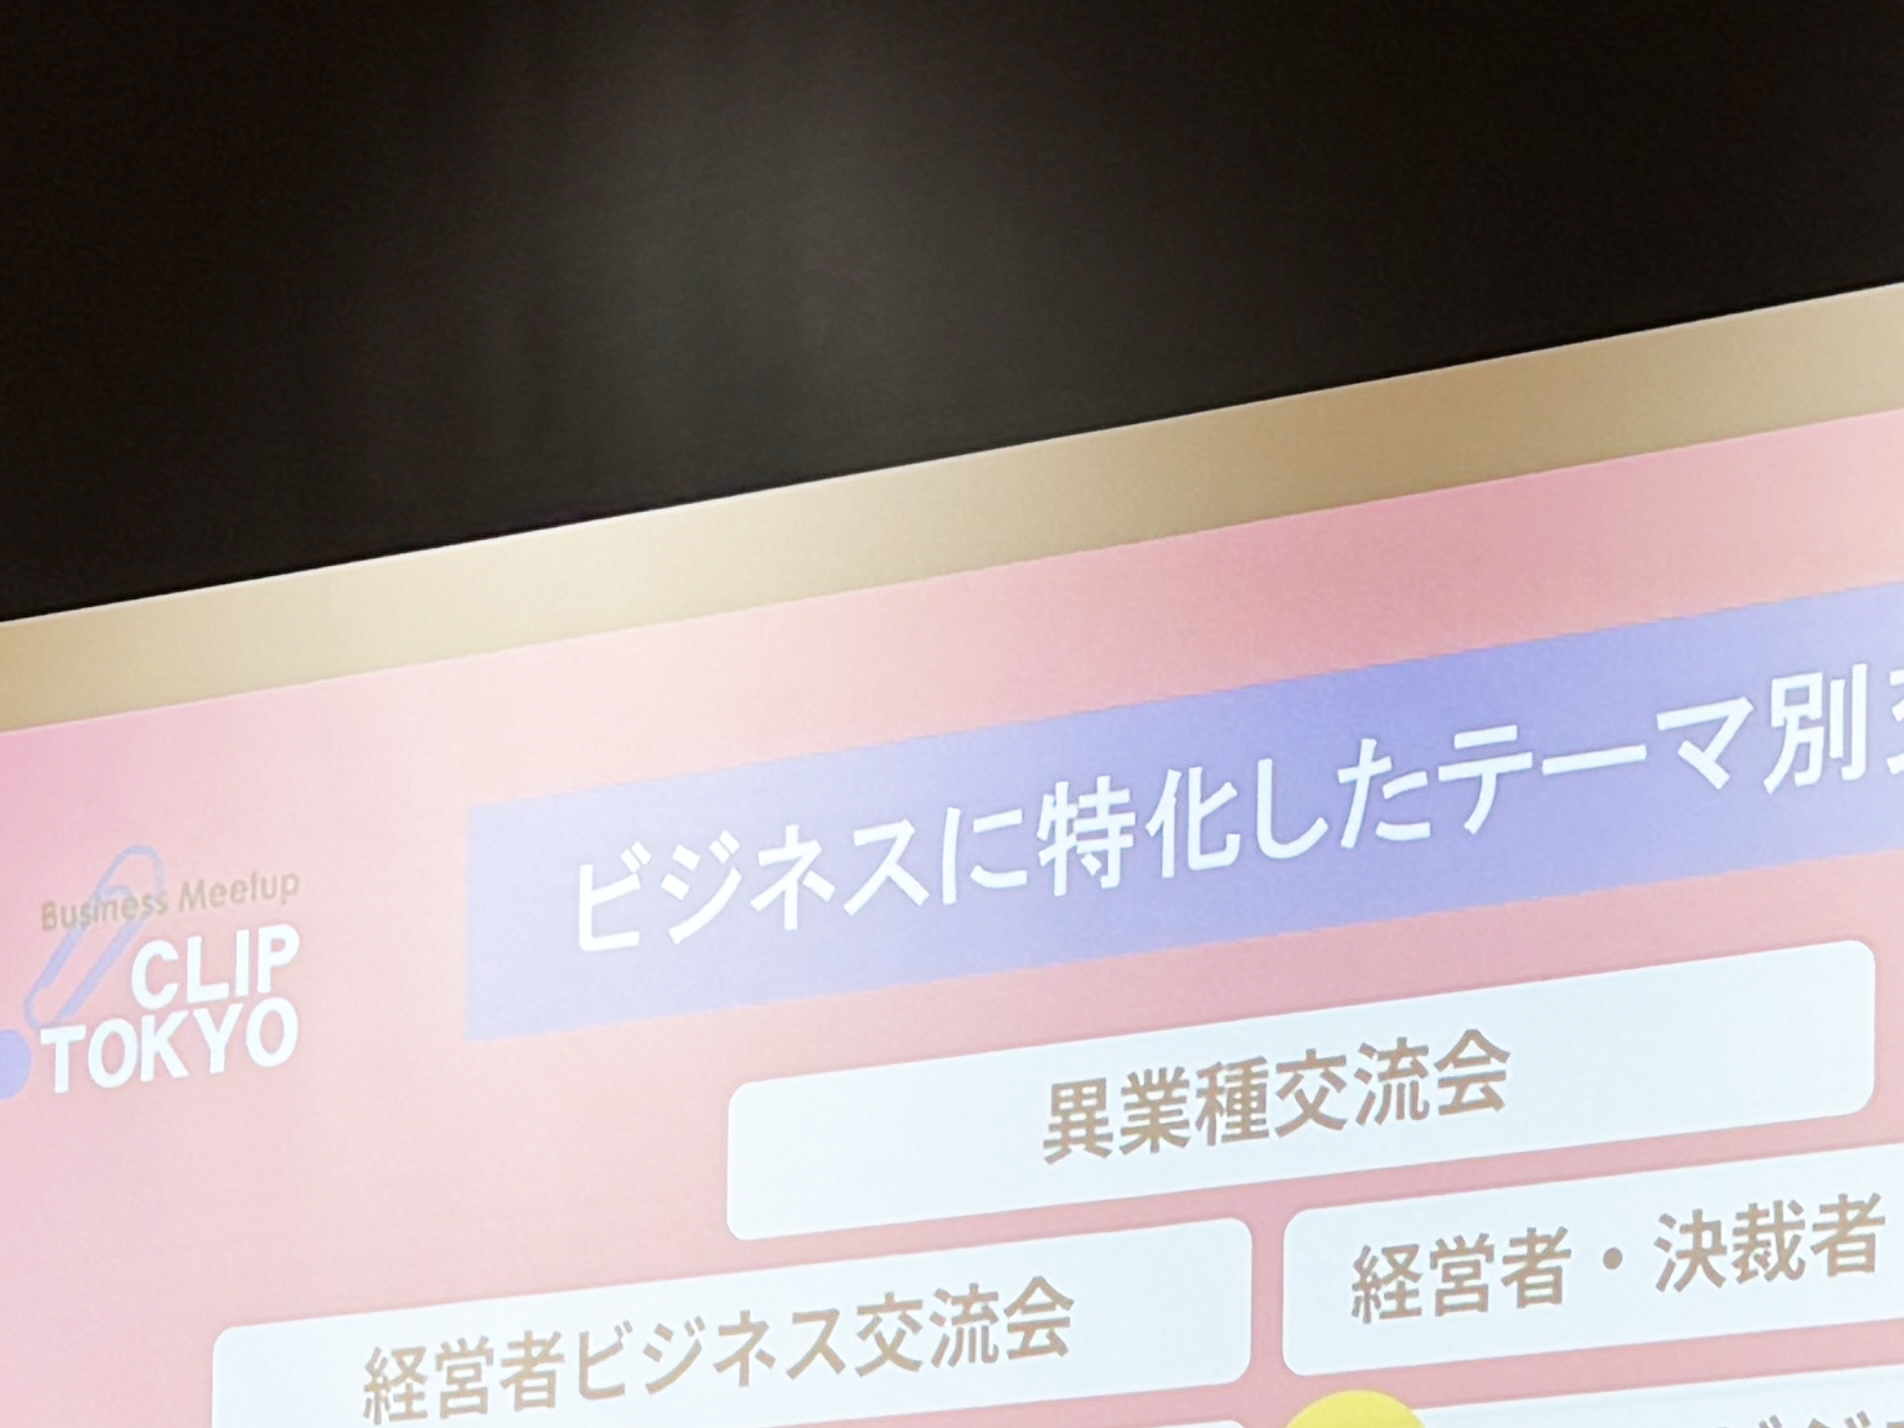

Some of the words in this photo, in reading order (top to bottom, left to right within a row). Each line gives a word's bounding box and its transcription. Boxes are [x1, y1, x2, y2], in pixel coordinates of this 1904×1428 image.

[41, 890, 170, 931] Business
[178, 871, 301, 911] Meetup
[131, 923, 301, 1011] CLIP
[39, 997, 299, 1095] TOKYO
[1043, 1027, 1510, 1167] 異業種交流会
[362, 1275, 1075, 1425] 経営者ビジネス交流会
